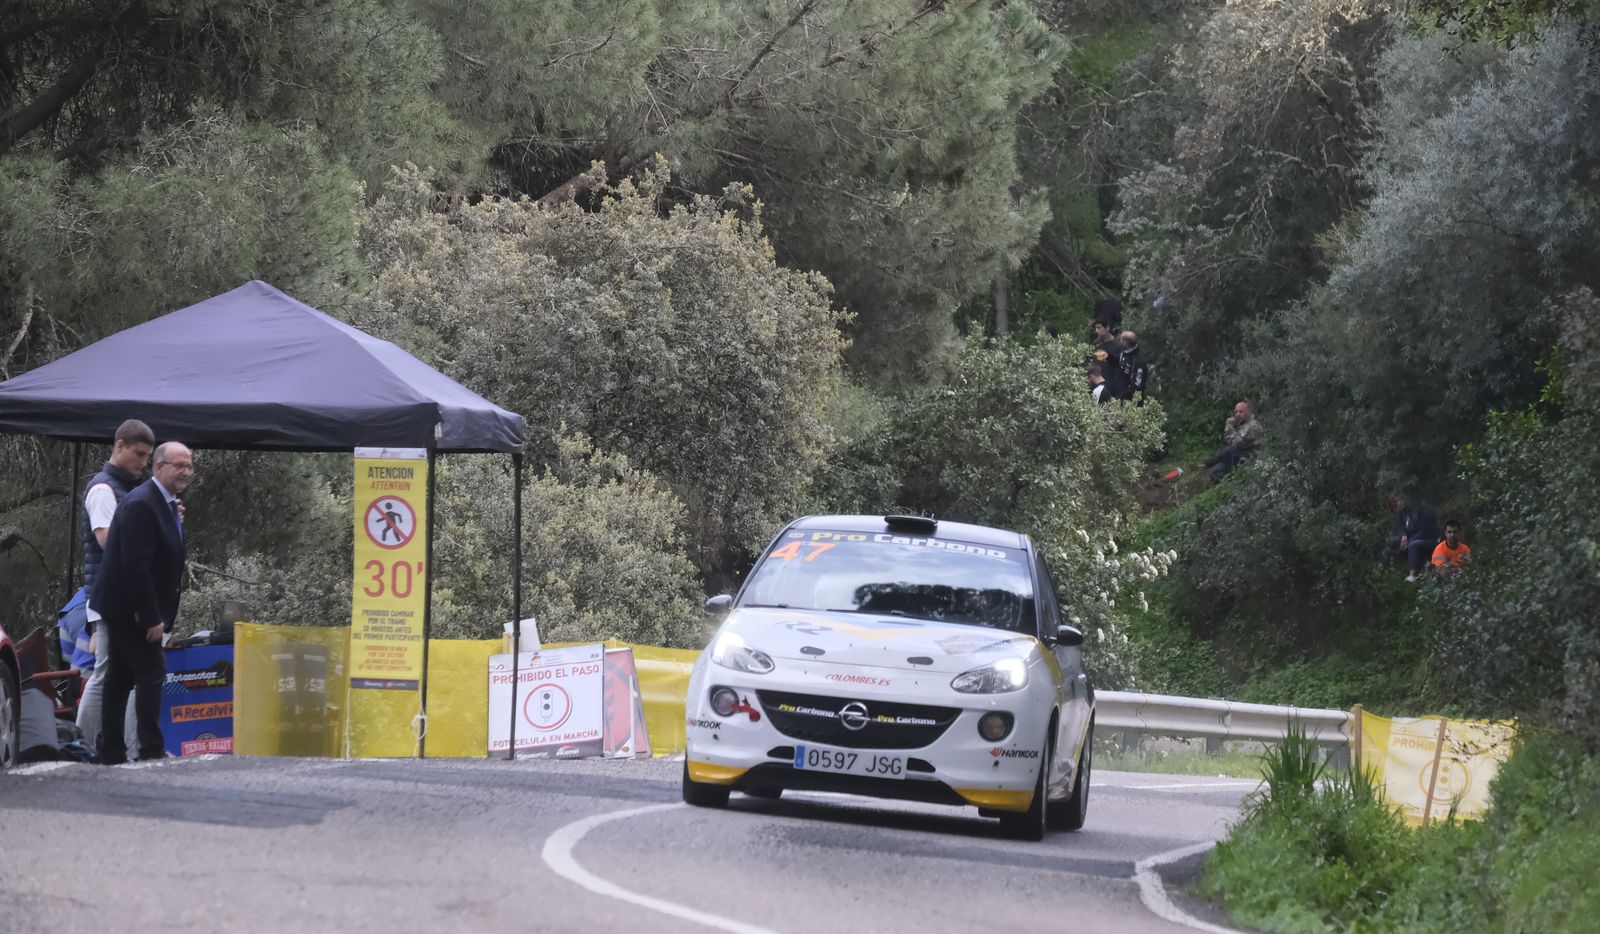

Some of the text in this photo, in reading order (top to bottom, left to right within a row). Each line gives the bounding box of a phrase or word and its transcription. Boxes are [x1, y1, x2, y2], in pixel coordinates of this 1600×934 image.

[368, 466, 413, 479] ATENCION
[369, 481, 411, 490] ATTENTION
[769, 540, 836, 562] 47
[811, 532, 1007, 559] Pro Carbono
[493, 664, 600, 685] PROHIBIDO EL PASO
[778, 703, 834, 718] Pro Carbono
[877, 715, 936, 725] Pro Carbono
[550, 734, 561, 742] EN
[564, 729, 599, 740] MARCHA
[808, 749, 902, 775] 0597 JSG
